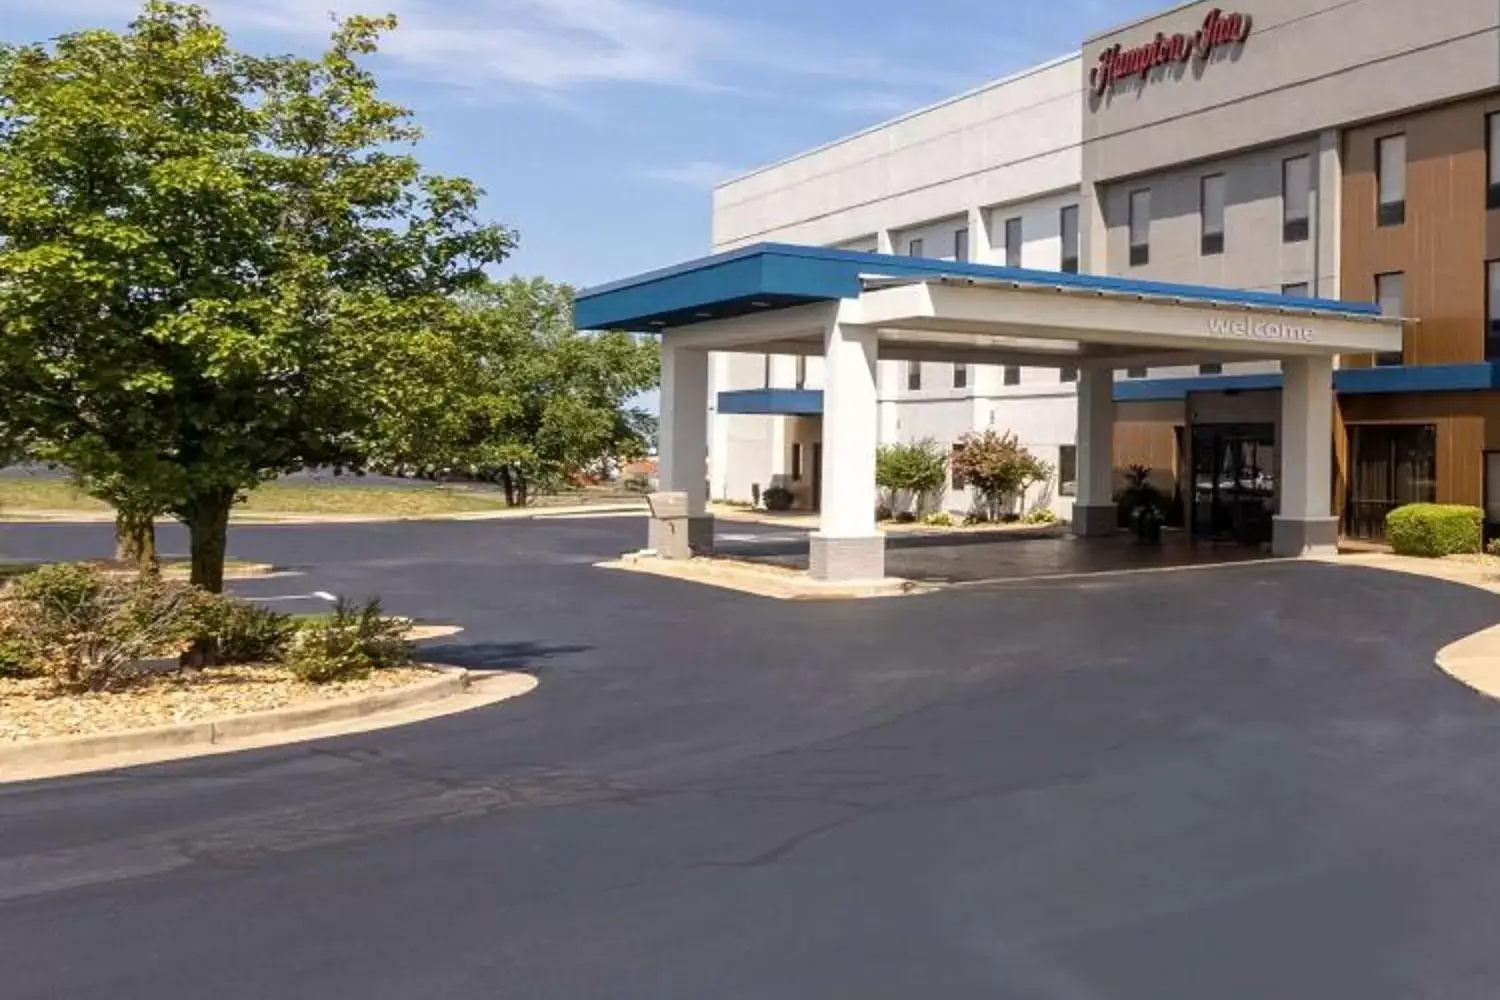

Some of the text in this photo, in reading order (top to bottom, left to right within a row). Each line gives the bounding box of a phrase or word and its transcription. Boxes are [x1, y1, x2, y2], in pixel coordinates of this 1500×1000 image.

[1089, 8, 1252, 96] Hampton Inn
[1208, 316, 1315, 342] welcome
